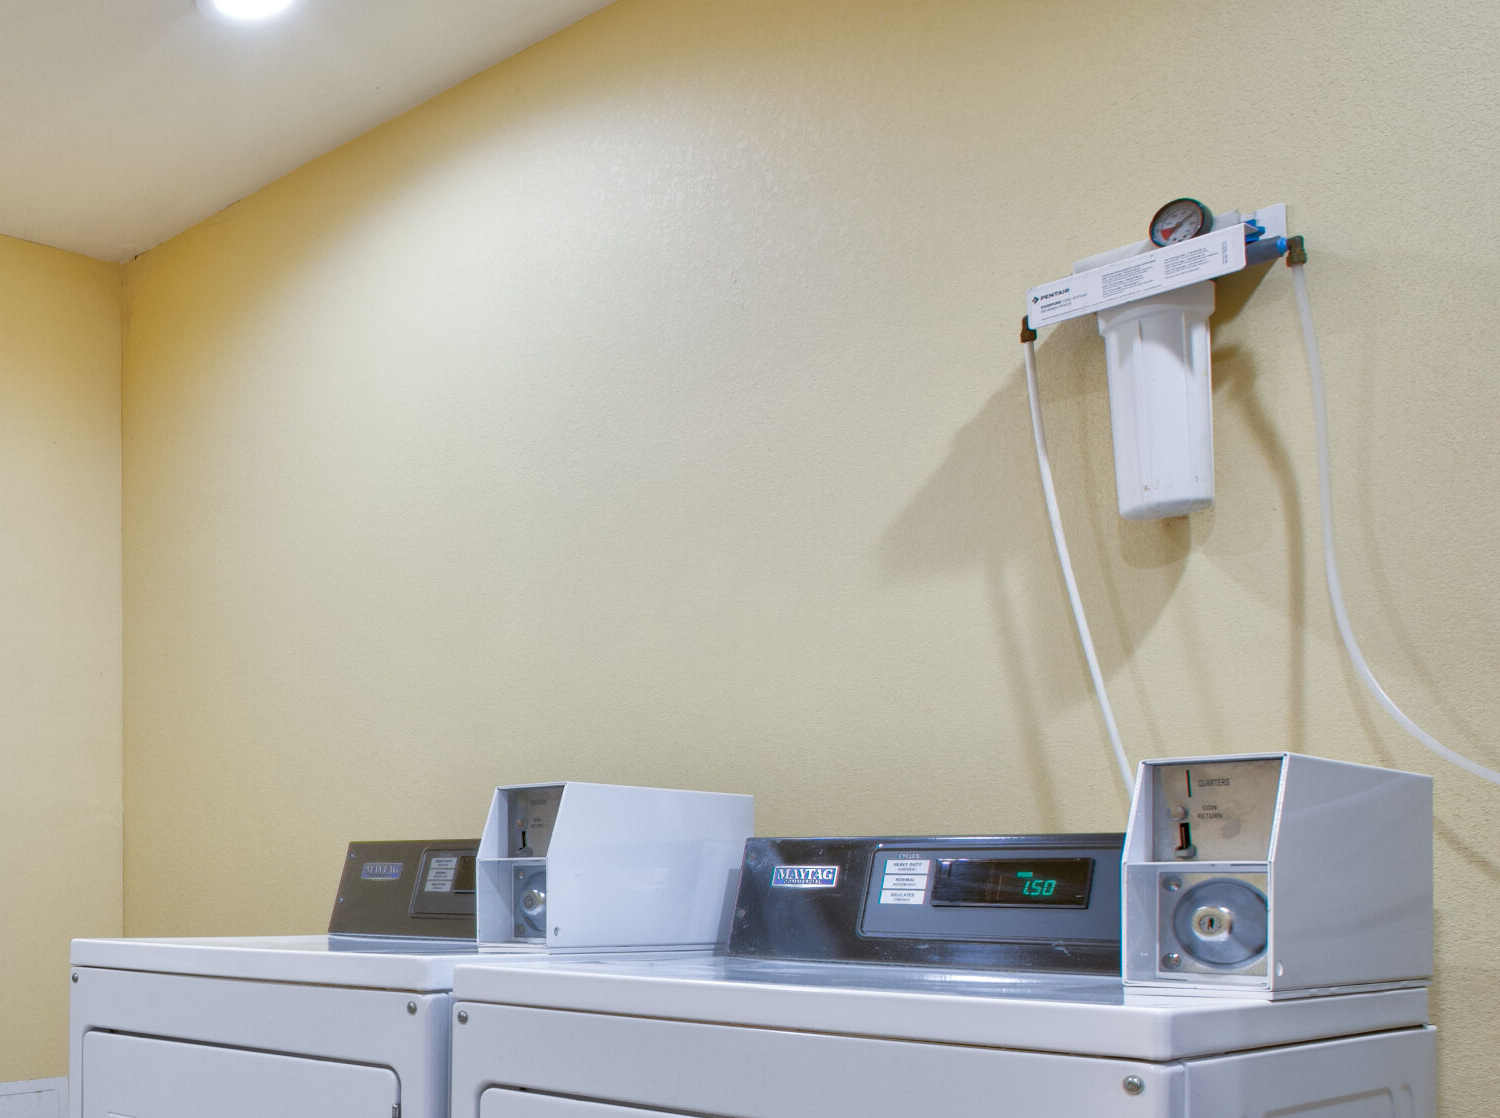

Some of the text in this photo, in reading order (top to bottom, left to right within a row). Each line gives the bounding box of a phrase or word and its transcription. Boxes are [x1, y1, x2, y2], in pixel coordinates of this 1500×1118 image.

[1040, 288, 1070, 301] PENTAIR
[1198, 778, 1230, 787] QUARTERS
[777, 868, 833, 879] MAYTAG
[1023, 879, 1057, 896] 1.50
